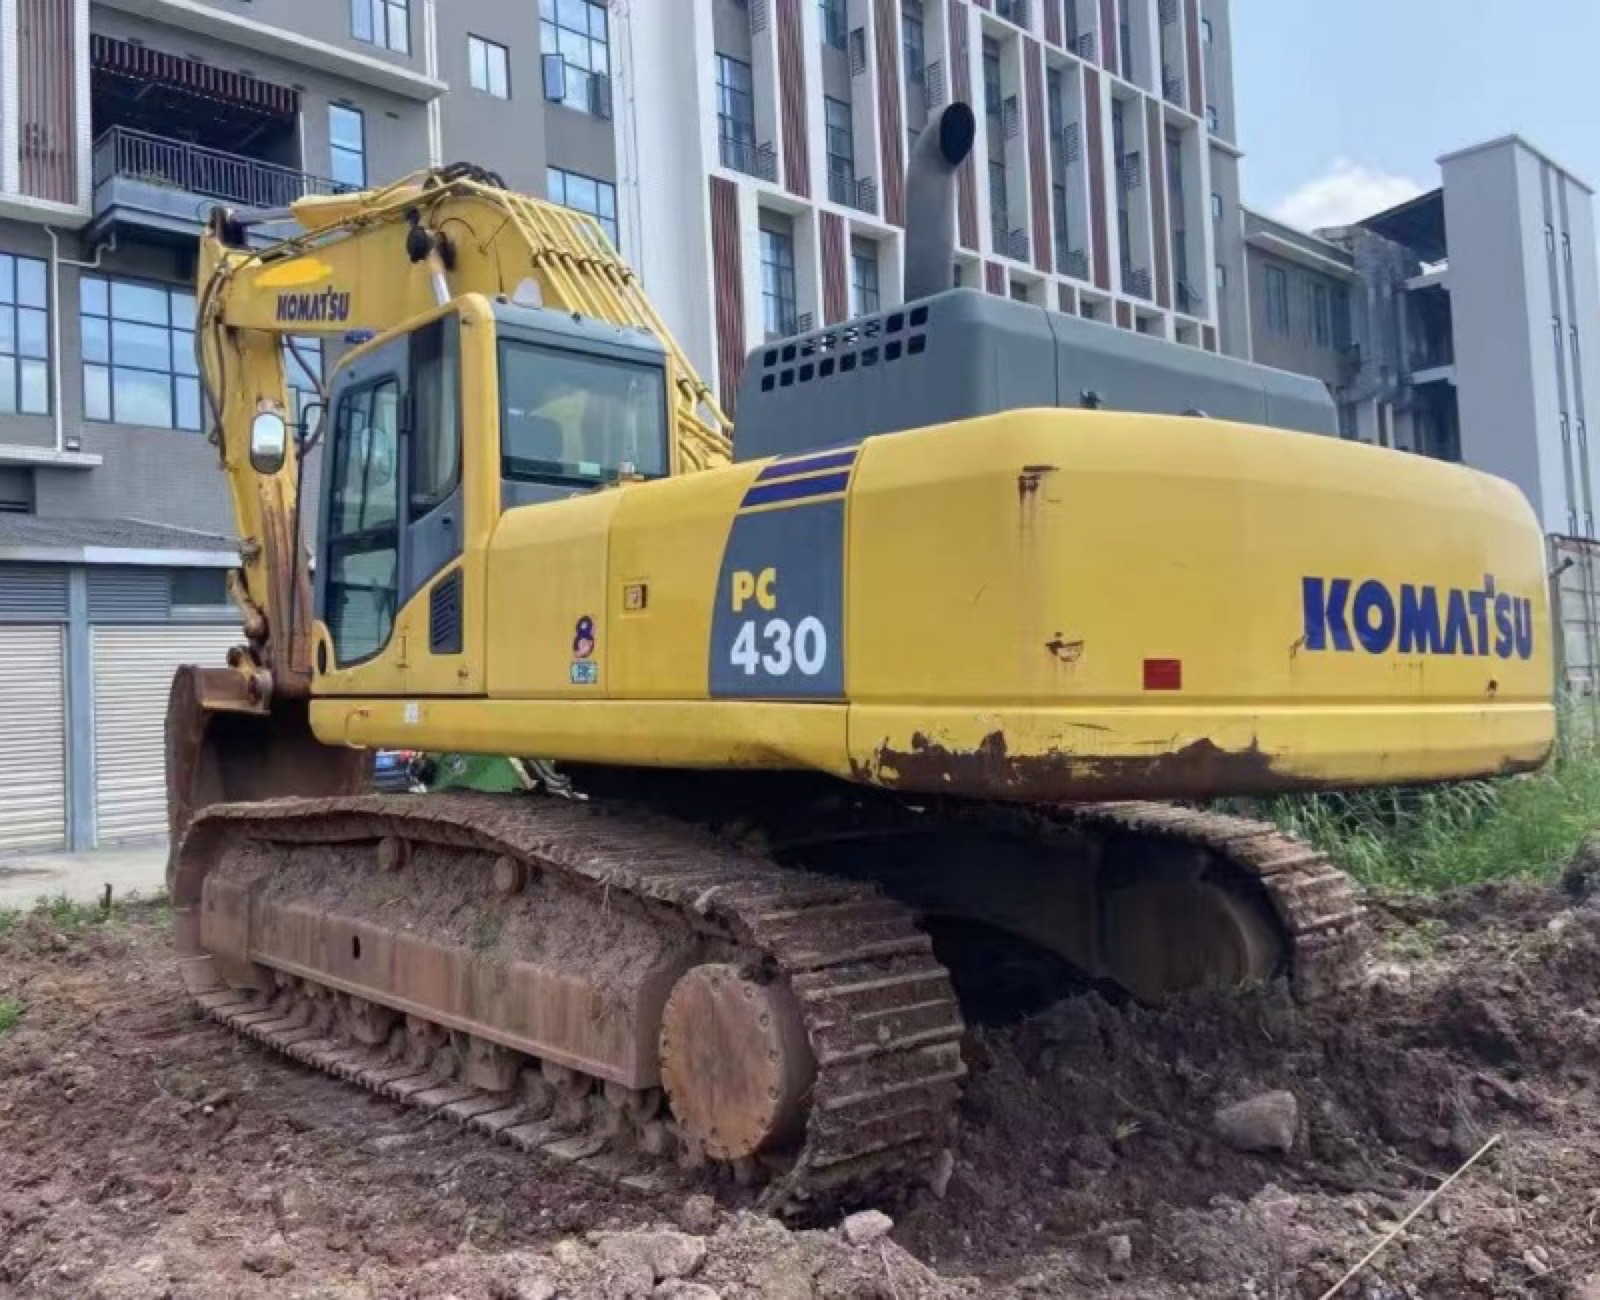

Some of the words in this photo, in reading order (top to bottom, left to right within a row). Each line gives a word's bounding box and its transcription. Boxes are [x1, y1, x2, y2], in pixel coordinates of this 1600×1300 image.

[276, 285, 350, 321] KOMATSU
[732, 567, 777, 612] PC
[1302, 573, 1532, 660] KOMATSU
[730, 615, 827, 676] 430
